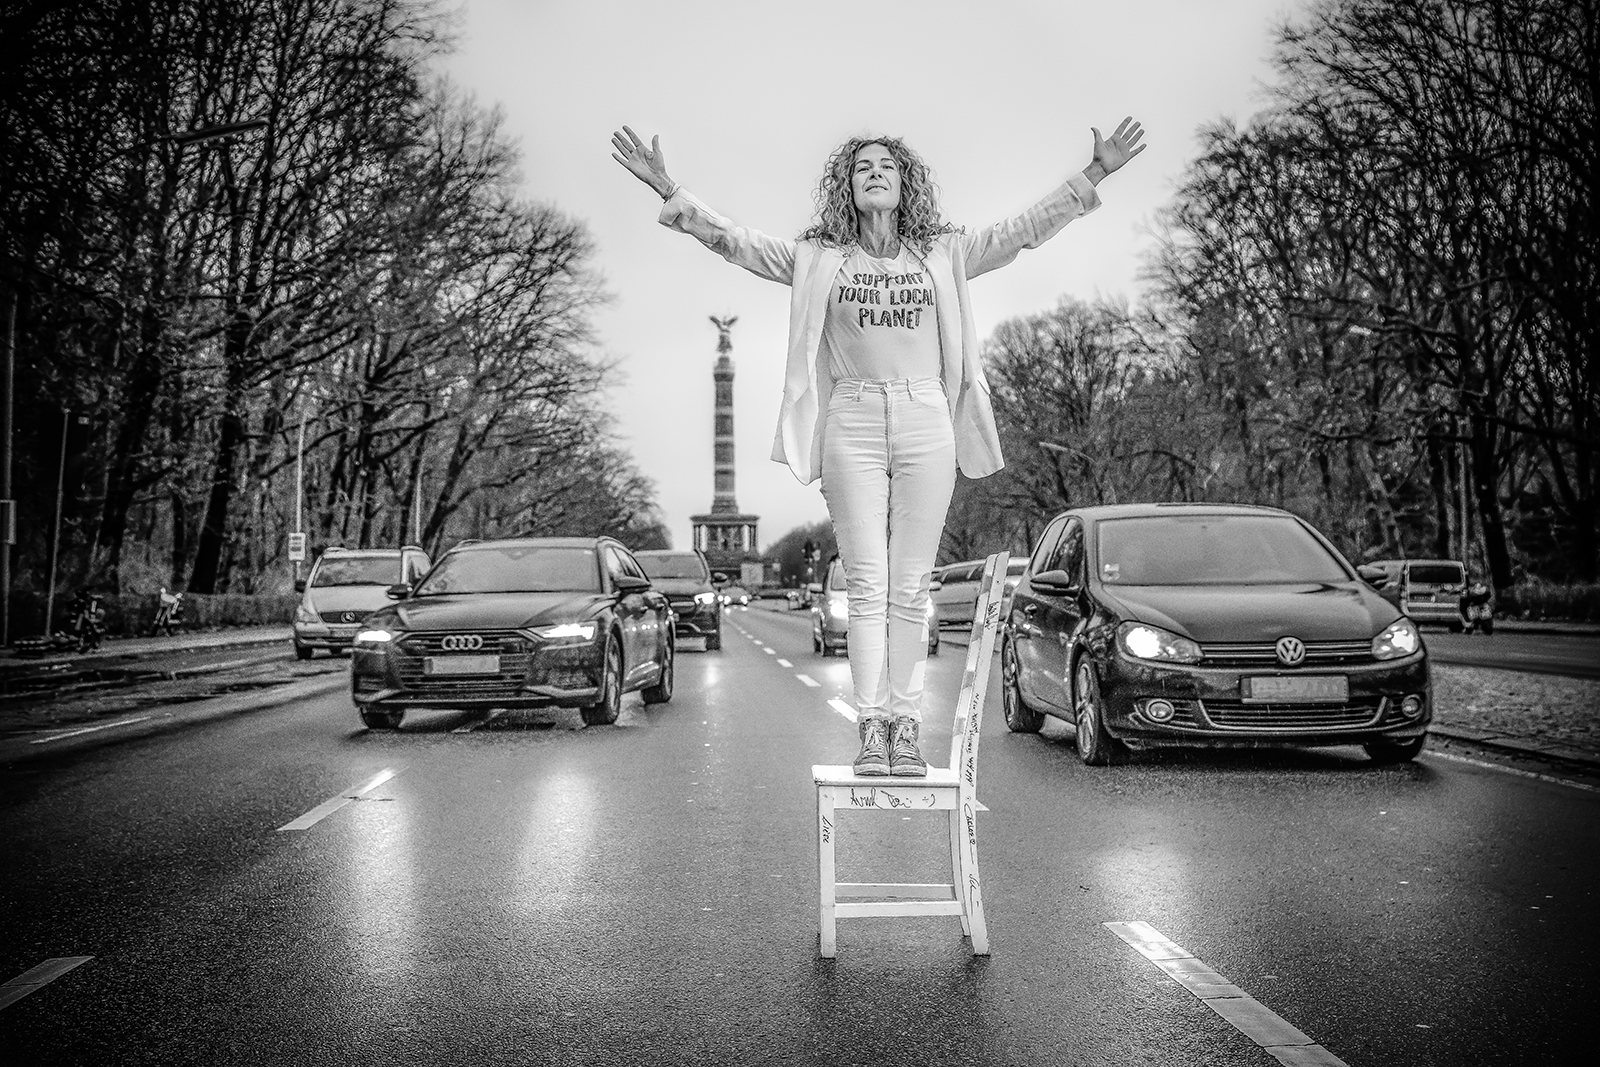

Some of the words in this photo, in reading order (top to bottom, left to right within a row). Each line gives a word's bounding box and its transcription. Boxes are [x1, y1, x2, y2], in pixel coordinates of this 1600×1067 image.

[852, 272, 924, 289] SUPPORT
[838, 285, 881, 305] YOUR
[889, 288, 934, 306] LOCAL
[858, 307, 923, 330] PLANET
